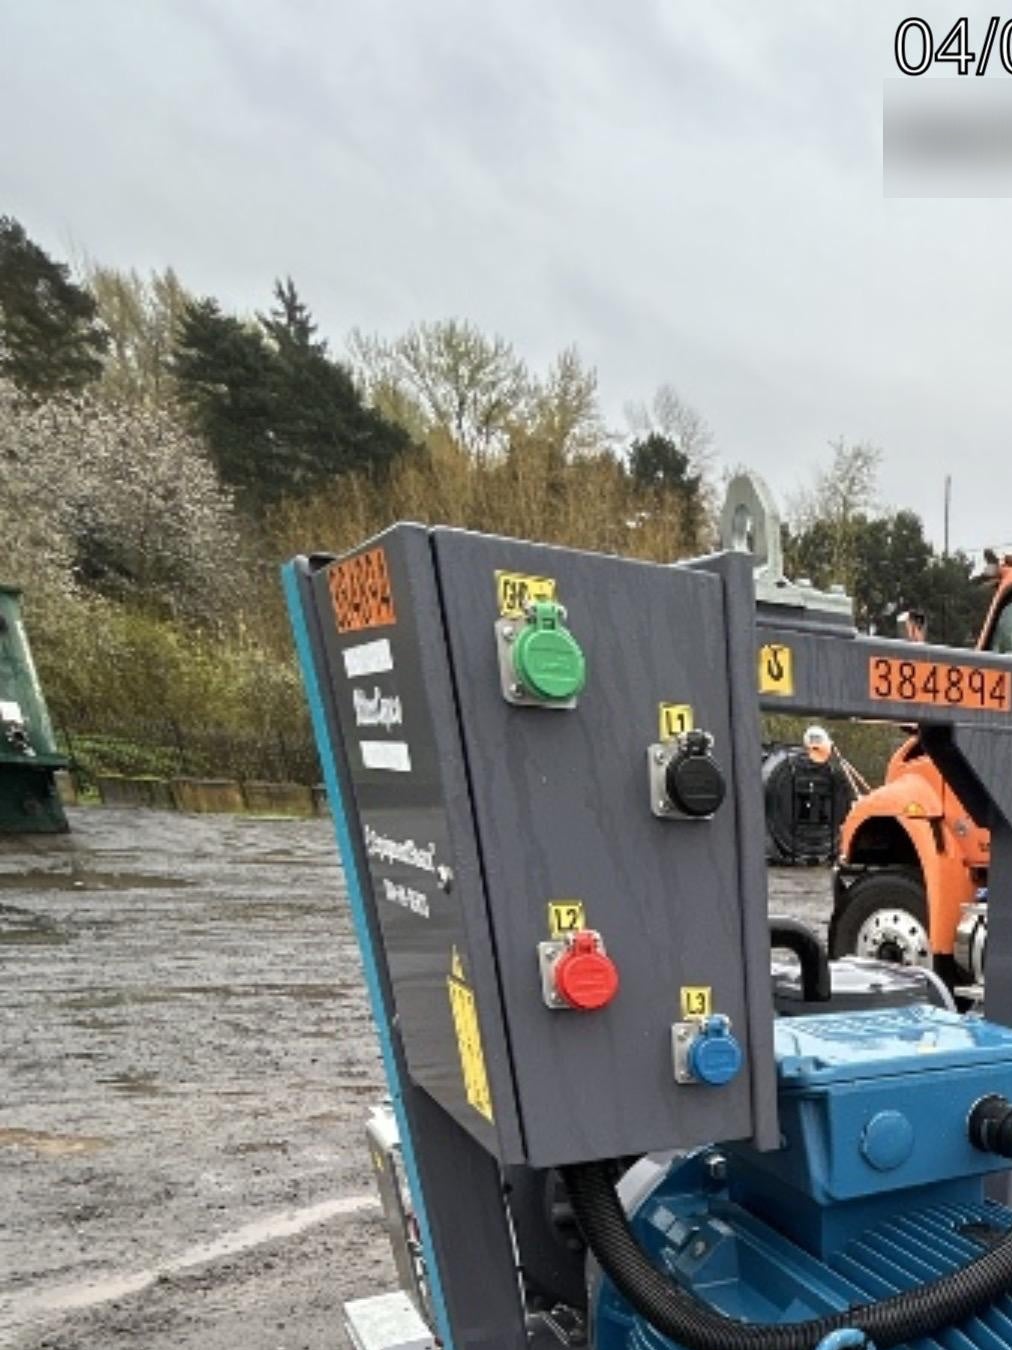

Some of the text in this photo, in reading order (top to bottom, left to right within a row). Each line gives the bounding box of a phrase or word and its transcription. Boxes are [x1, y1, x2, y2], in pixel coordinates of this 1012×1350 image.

[874, 659, 1006, 708] 384894
[665, 711, 685, 736] L1
[554, 909, 579, 931] L2
[686, 992, 706, 1015] L3
